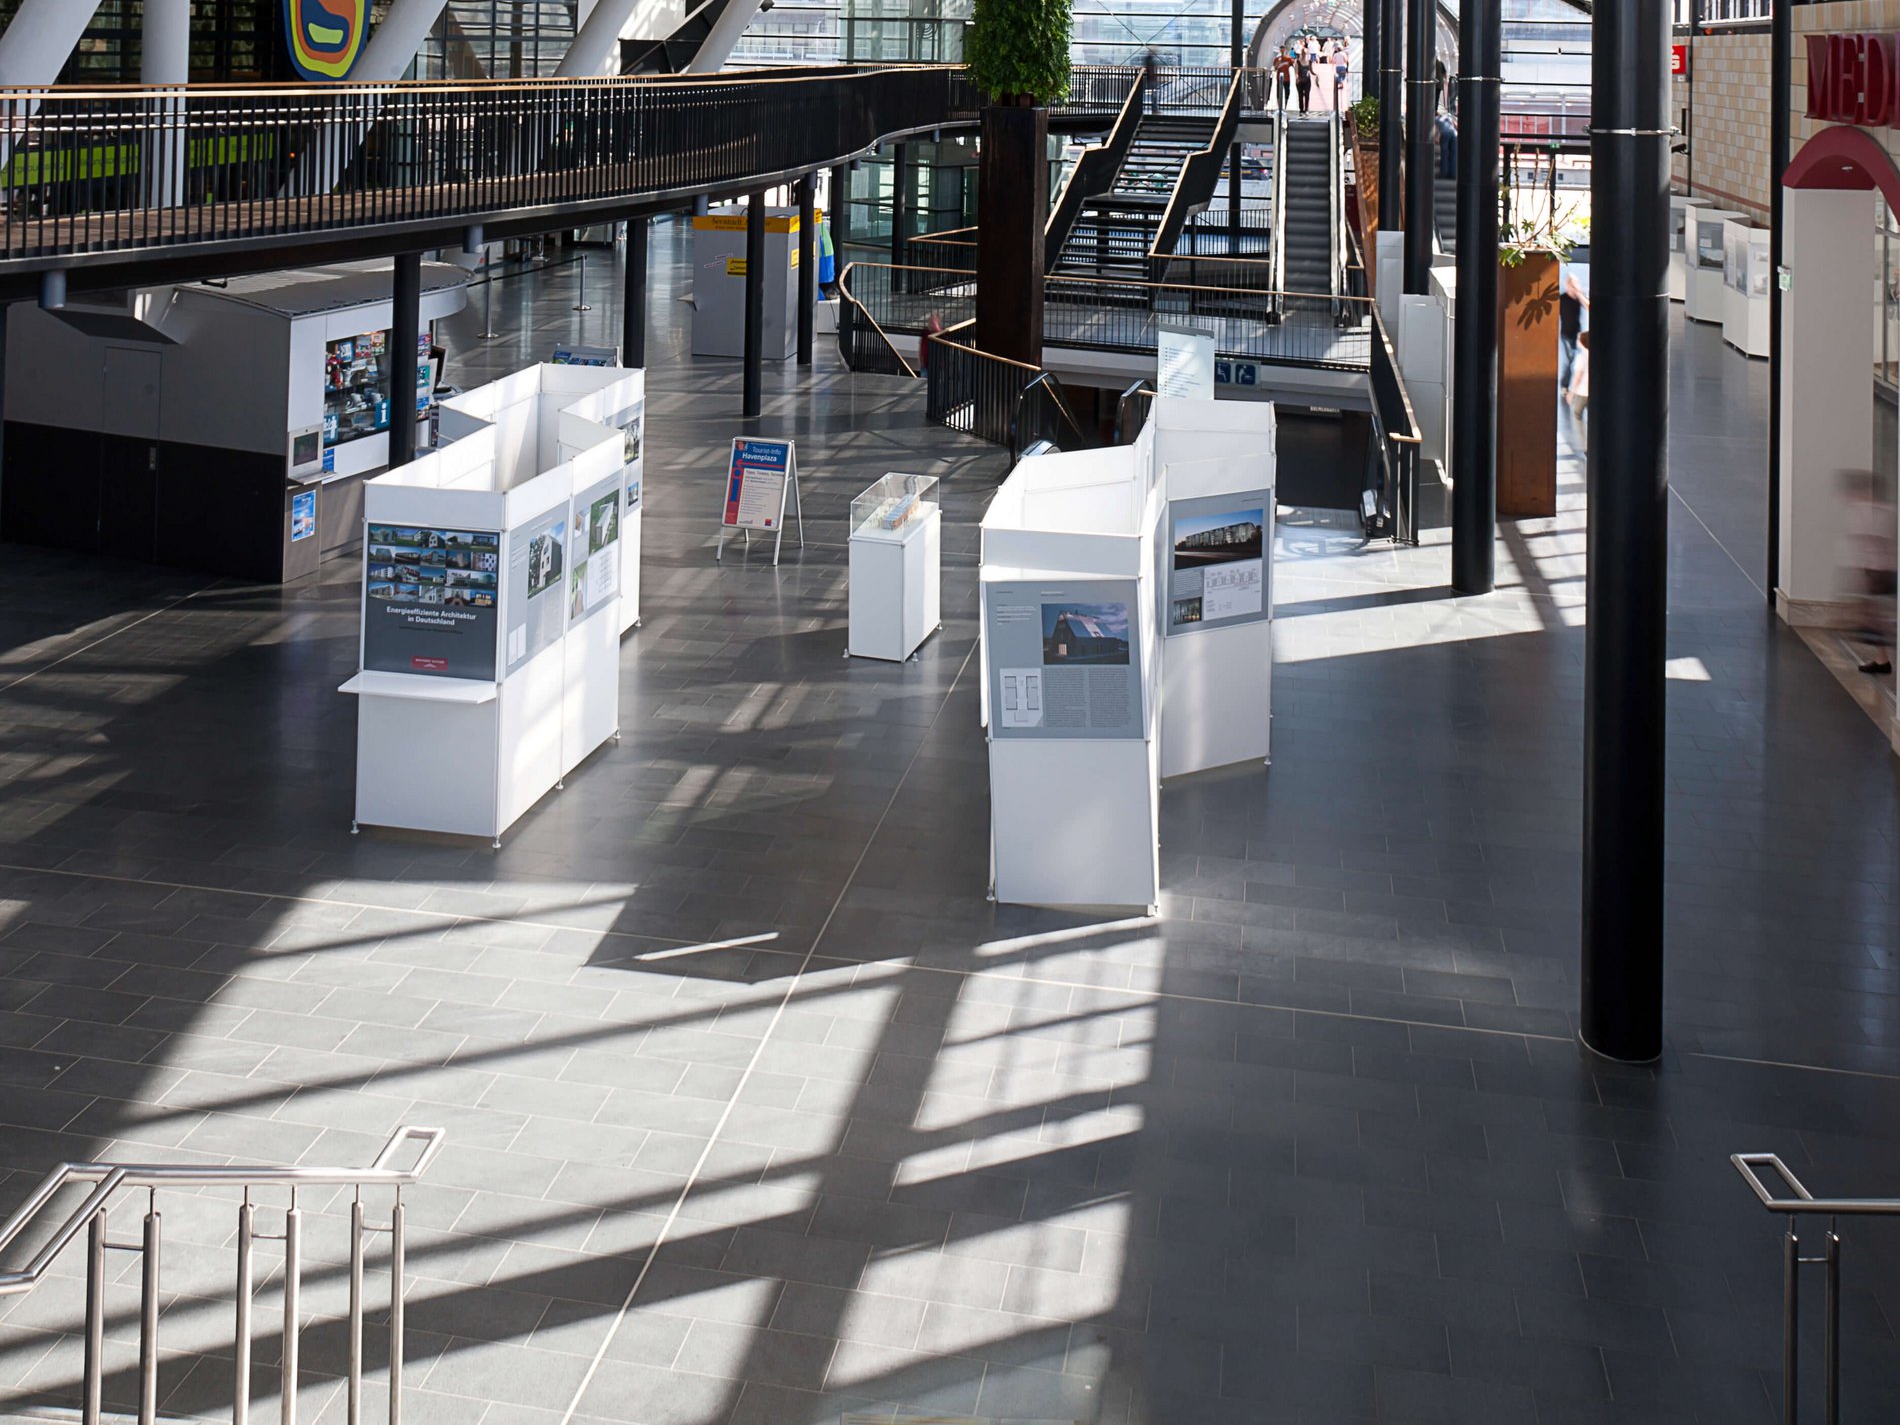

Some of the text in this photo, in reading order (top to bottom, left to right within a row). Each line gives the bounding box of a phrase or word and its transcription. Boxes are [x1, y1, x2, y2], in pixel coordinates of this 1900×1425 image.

[752, 446, 782, 455] Tourist-Info
[742, 452, 777, 462] Havenplaza
[386, 605, 477, 621] Energieeffiziente Architektur
[407, 614, 455, 626] in Deutschland
